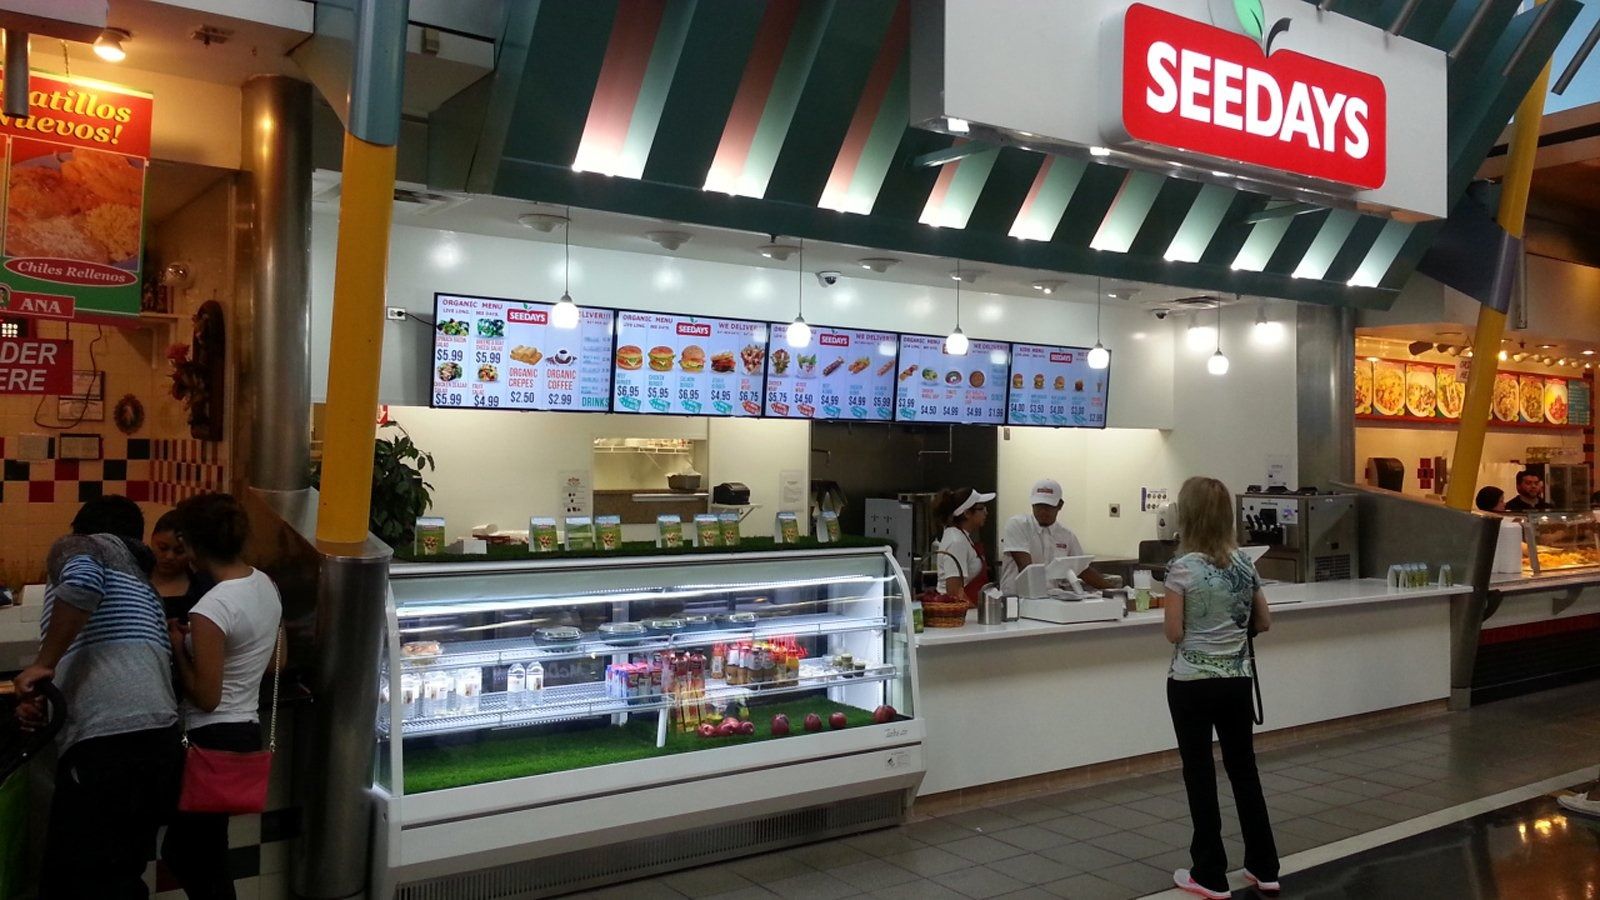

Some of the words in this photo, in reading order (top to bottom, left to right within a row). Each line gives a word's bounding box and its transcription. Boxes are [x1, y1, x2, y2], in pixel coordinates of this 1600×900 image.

[0, 88, 132, 123] atillos
[1146, 41, 1370, 159] SEEDAYS
[17, 261, 62, 276] Chiles
[66, 266, 126, 282] Rellenos
[20, 298, 61, 313] ANA
[442, 299, 478, 308] ORGANIC
[509, 311, 546, 322] SEEDAYS
[622, 314, 652, 322] ORGANIC
[655, 316, 673, 324] MENU
[678, 325, 709, 334] SEEDAYS
[821, 335, 848, 345] SEEDAYS
[437, 349, 463, 361] $5.99
[476, 351, 501, 364] $5.99
[509, 367, 538, 378] ORGANIC
[547, 369, 576, 379] ORGANIC
[509, 378, 534, 388] CREPES
[548, 380, 573, 390] COFFEE
[617, 385, 639, 397] $6.95
[648, 387, 669, 398] $5.95
[678, 389, 699, 400] $6.95
[711, 390, 731, 401] $4.95
[435, 392, 462, 405] $5.99
[474, 394, 499, 407] $4.99
[510, 391, 535, 403] $2.50
[548, 393, 572, 405] $2.99
[581, 397, 609, 407] DRINKS
[768, 392, 787, 402] $5.75
[920, 405, 937, 415] $4.50
